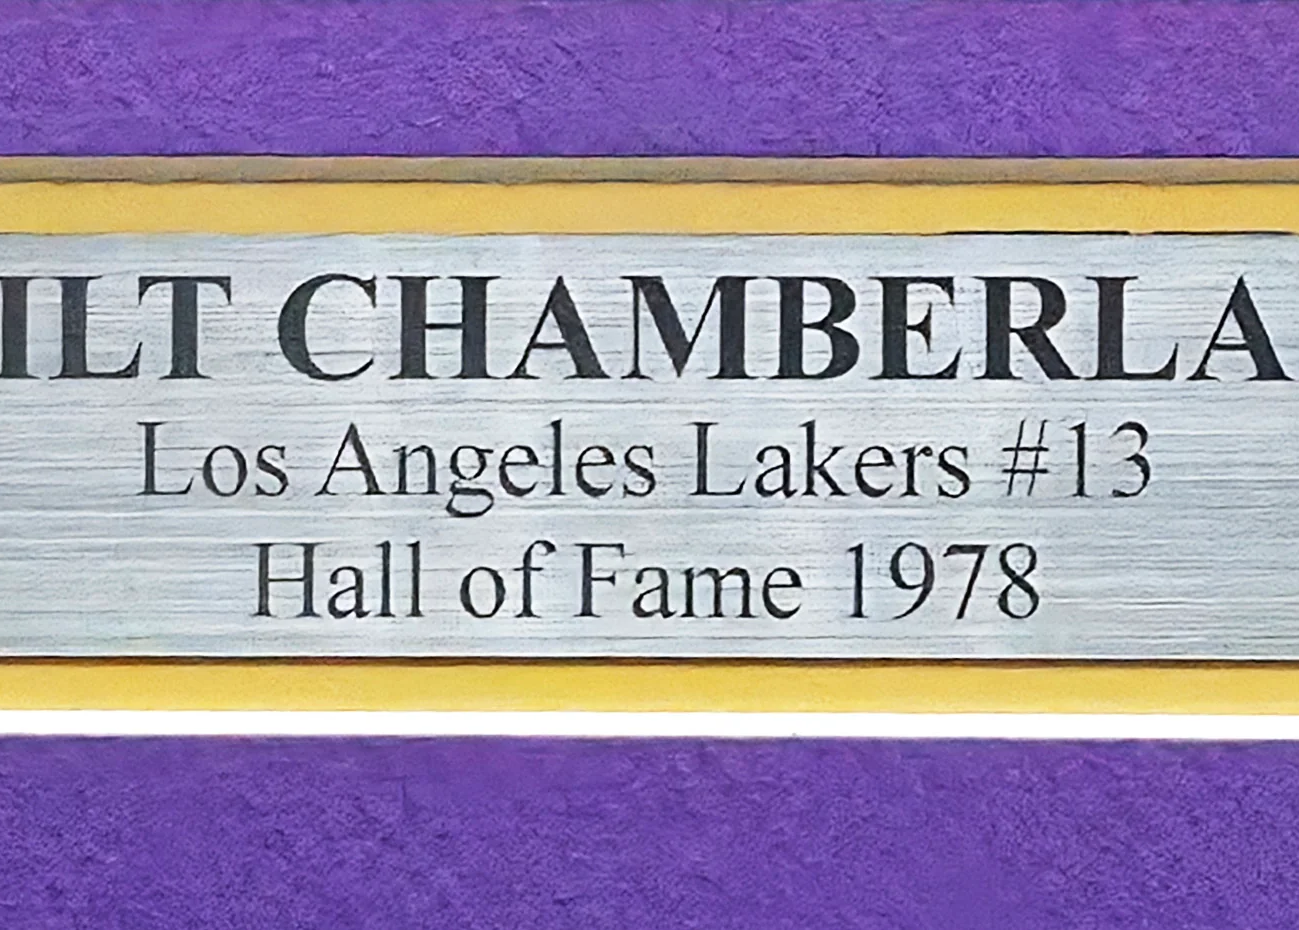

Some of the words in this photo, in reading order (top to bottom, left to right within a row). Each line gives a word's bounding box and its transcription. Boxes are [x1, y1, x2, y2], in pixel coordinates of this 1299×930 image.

[137, 421, 290, 497] Los
[314, 419, 657, 518] Angeles
[690, 420, 971, 499] Lakers
[1001, 420, 1152, 499] #13
[253, 540, 424, 619] Hall
[459, 540, 556, 619] of
[575, 542, 803, 620] Fame
[845, 541, 1041, 621] 1978
